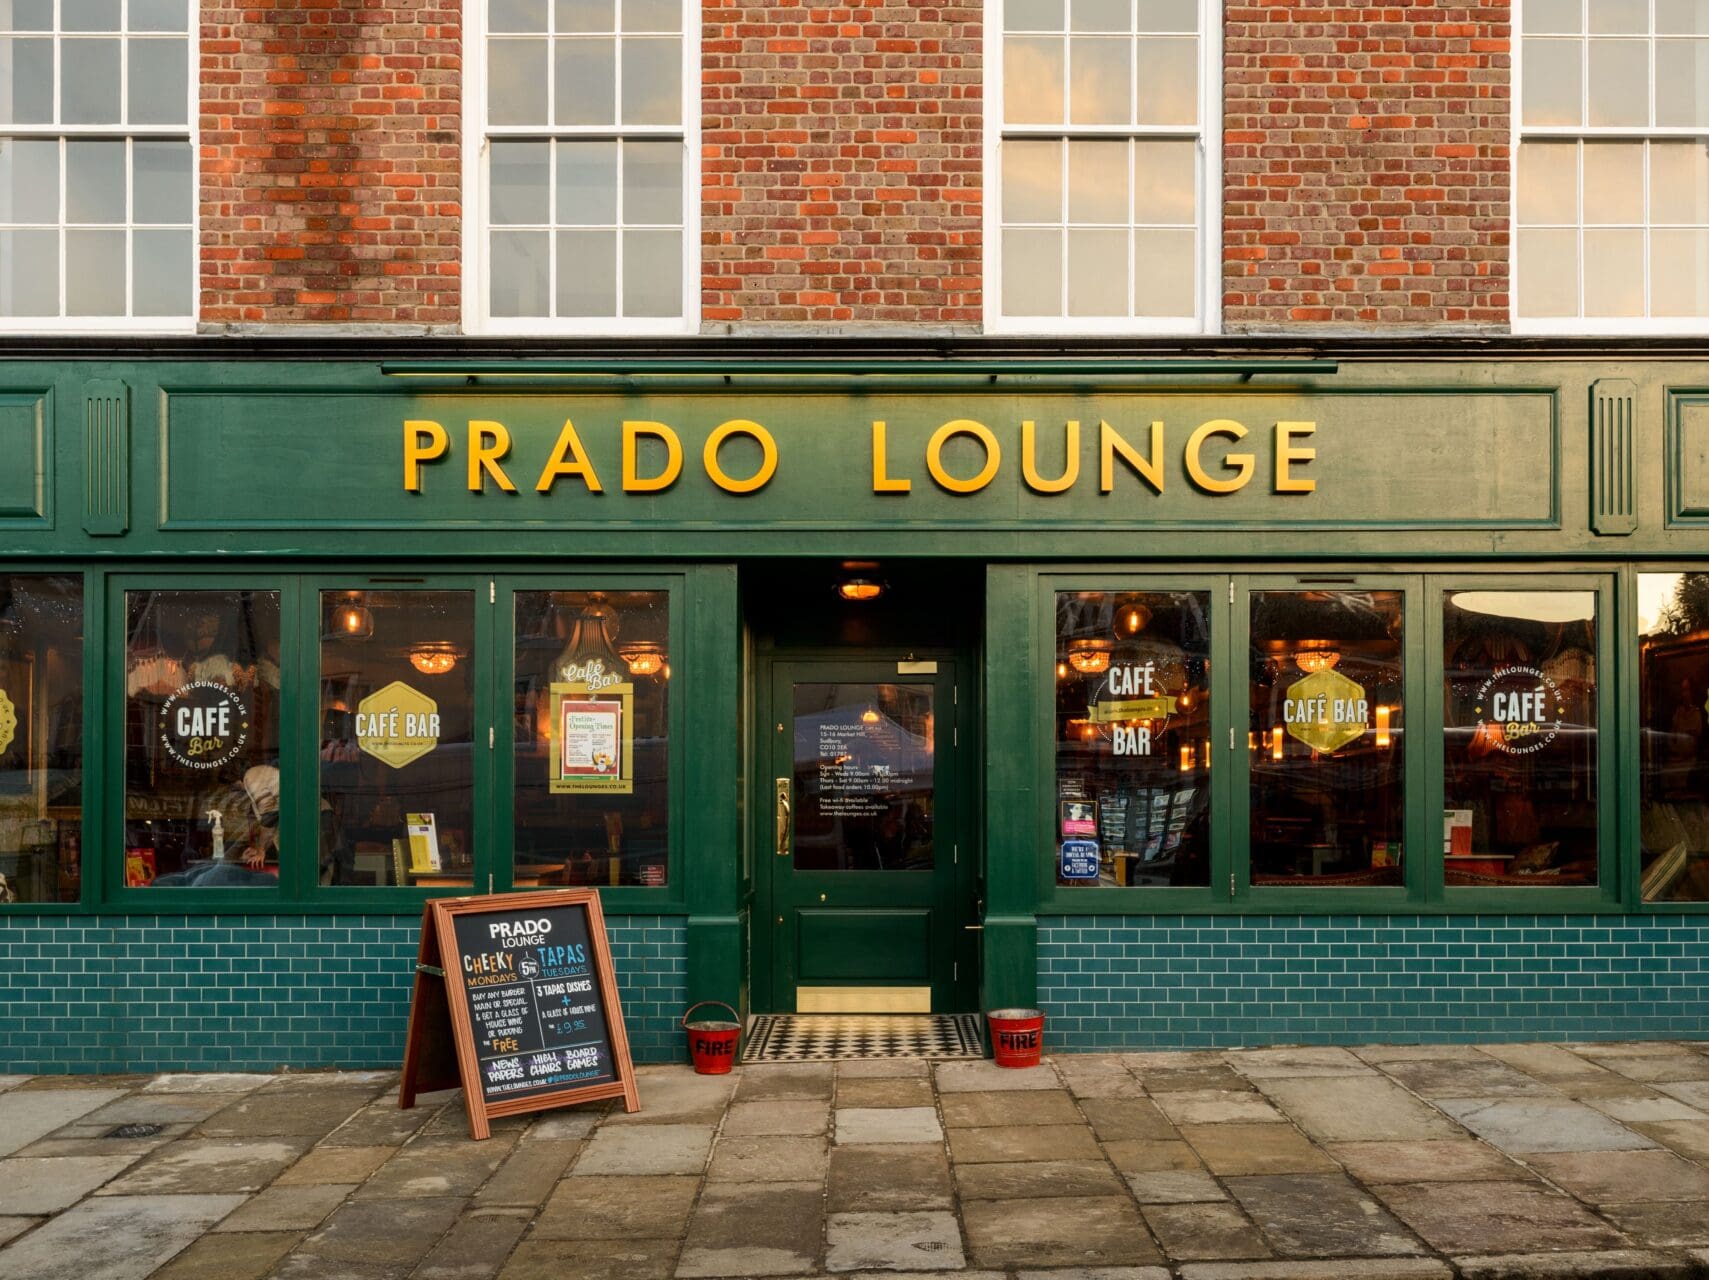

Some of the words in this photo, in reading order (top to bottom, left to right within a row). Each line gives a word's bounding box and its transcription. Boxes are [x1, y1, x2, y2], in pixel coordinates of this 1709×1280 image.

[402, 417, 779, 494] PRADO
[871, 417, 1318, 494] LOUNGE
[562, 659, 605, 683] Café
[1109, 661, 1155, 695] CAFÉ
[588, 672, 622, 691] Bar
[1477, 666, 1562, 701] WWW.THELOUNGES.CO.UK
[161, 681, 247, 716] WWW.THELOUNGES.CO.UK
[1493, 685, 1546, 722] CAFÉ
[177, 699, 230, 737] CAFÉ
[1283, 693, 1328, 724] CAFÉ
[1334, 699, 1369, 723] BAR
[355, 707, 399, 737] CAFÉ
[405, 713, 440, 737] BAR
[1504, 722, 1541, 741] Bar
[187, 736, 224, 756] Bar
[1113, 727, 1151, 755] BAR
[161, 734, 247, 769] WWW.THELOUNGES.CO.UK
[489, 919, 552, 939] PRADO
[502, 934, 546, 949] LOUNGE
[463, 950, 513, 974] CHEEKY
[537, 943, 586, 967] TAPAS
[467, 972, 518, 987] MONDAYS
[541, 965, 588, 978] TUESDAYS
[472, 991, 487, 1002] BUY
[487, 989, 501, 999] ANY
[535, 985, 543, 997] 3
[543, 983, 565, 995] TAPAS
[566, 980, 592, 994] DISHES
[474, 1001, 492, 1011] MAIN
[493, 1000, 502, 1008] OR
[503, 997, 528, 1008] SPECIAL
[482, 1011, 493, 1020] GET
[495, 1010, 500, 1019] A
[501, 1008, 519, 1018] GLASS
[485, 1018, 507, 1030] HOUSE
[507, 1016, 523, 1028] WINE
[492, 1037, 519, 1053] FREE
[696, 1038, 733, 1056] FIRE
[1000, 1030, 1037, 1050] FIRE
[532, 1051, 557, 1065] HIGH
[564, 1046, 598, 1060] BOARD
[567, 1055, 599, 1070] GAMES
[491, 1057, 520, 1071] NEWS
[530, 1061, 562, 1077] CHAIRS
[487, 1067, 524, 1082] PAPERS
